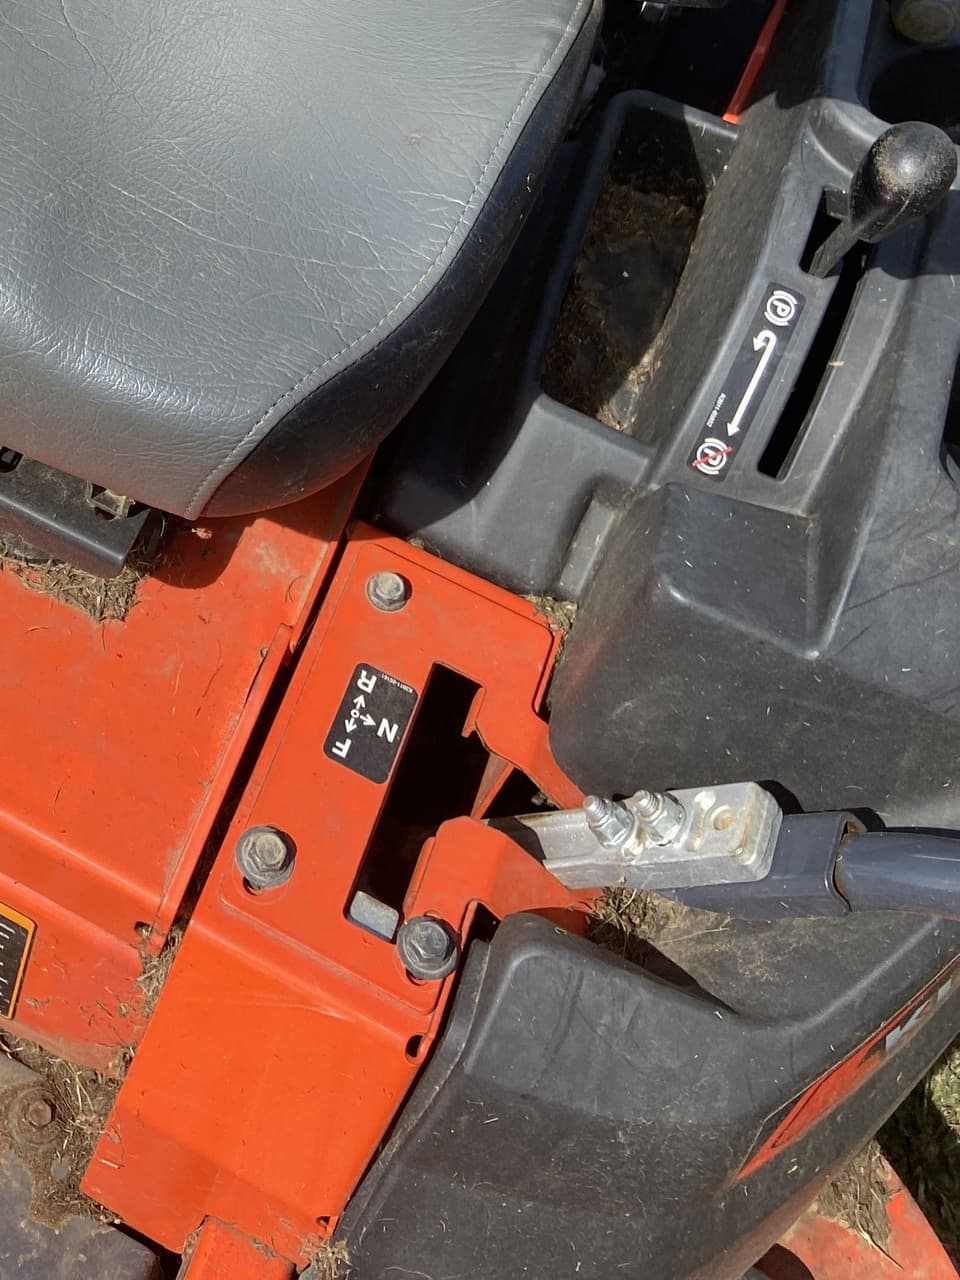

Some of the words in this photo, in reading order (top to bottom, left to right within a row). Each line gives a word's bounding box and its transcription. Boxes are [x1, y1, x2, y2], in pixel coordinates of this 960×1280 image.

[357, 669, 377, 694] R
[377, 718, 399, 743] N
[332, 738, 352, 758] F
